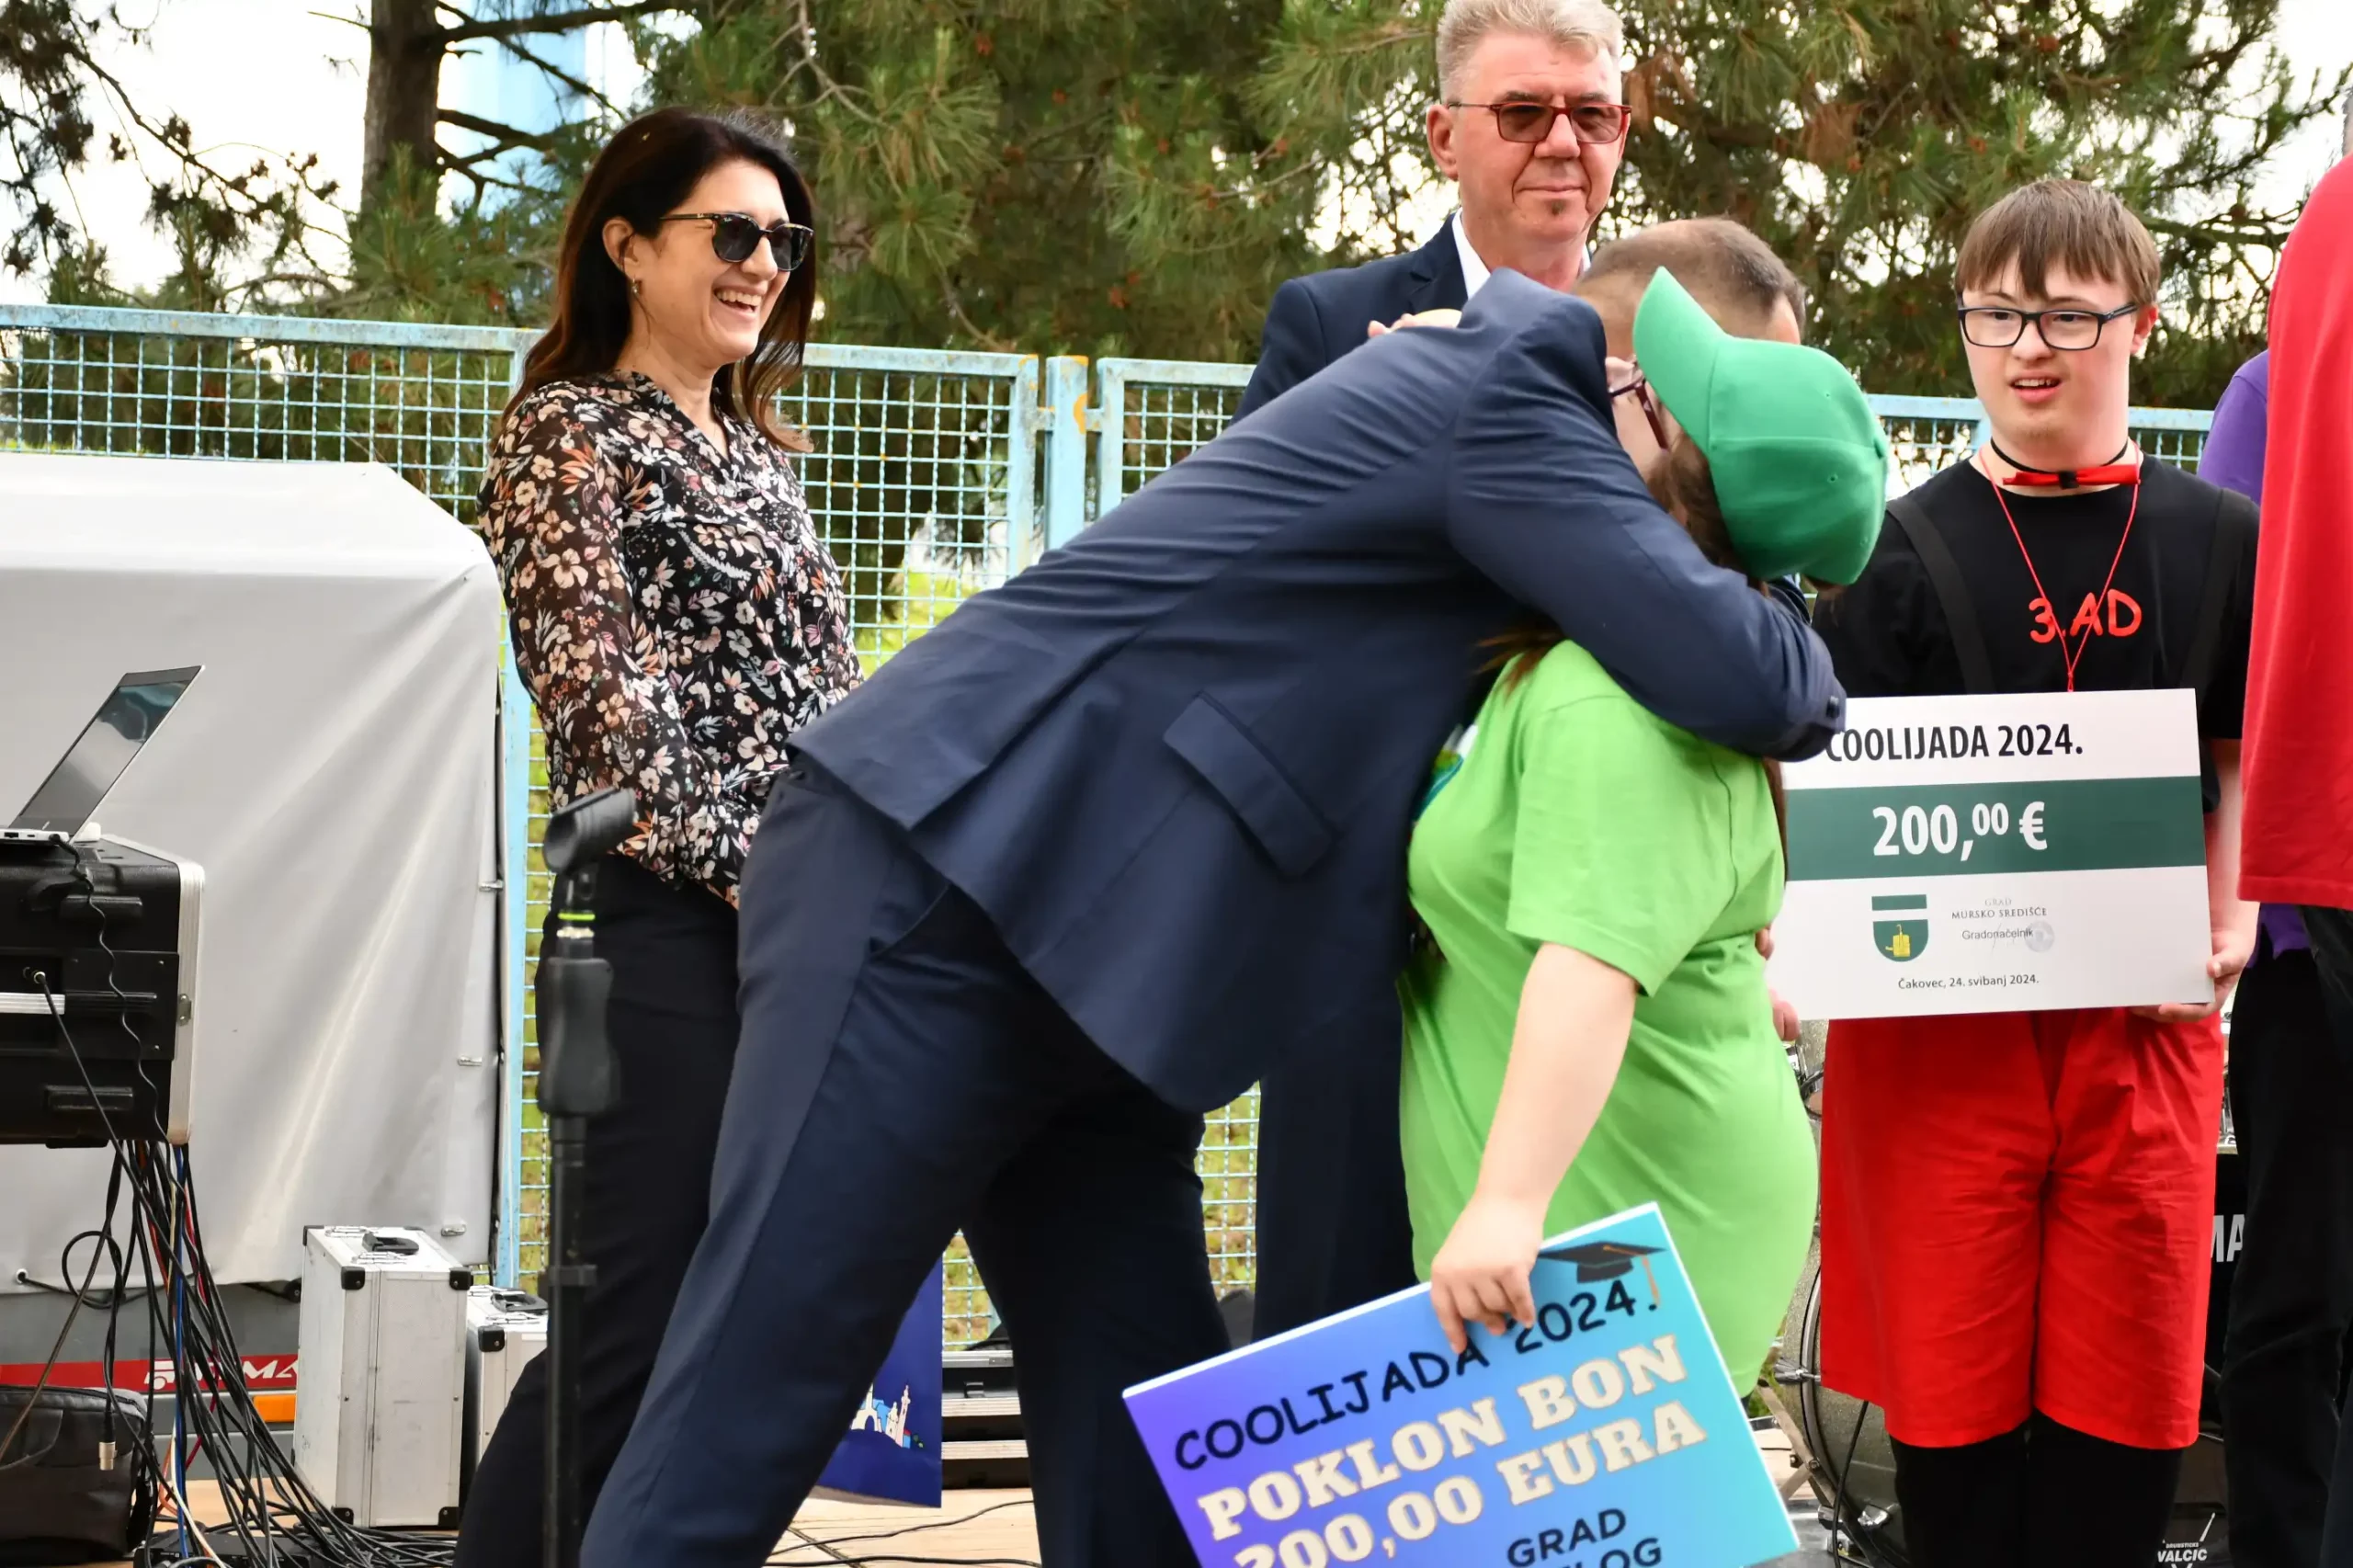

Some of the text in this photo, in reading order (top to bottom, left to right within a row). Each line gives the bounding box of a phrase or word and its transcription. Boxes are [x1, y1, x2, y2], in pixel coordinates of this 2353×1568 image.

[1997, 723, 2084, 757] 2024.
[1872, 801, 2048, 862] 200,00 €
[1951, 909, 1995, 920] MURSKO
[1984, 897, 2013, 907] GRAD
[1961, 927, 2034, 940] Gradonačelnik
[1898, 973, 2040, 990] Čakovec, 24. svibanj 2024.
[1175, 1335, 1490, 1471] COOLIJADA
[1197, 1334, 1688, 1542] POKLON BON
[1495, 1400, 1708, 1506] EURA
[1507, 1508, 1627, 1568] GRAD
[2157, 1549, 2208, 1562] VALCIC
